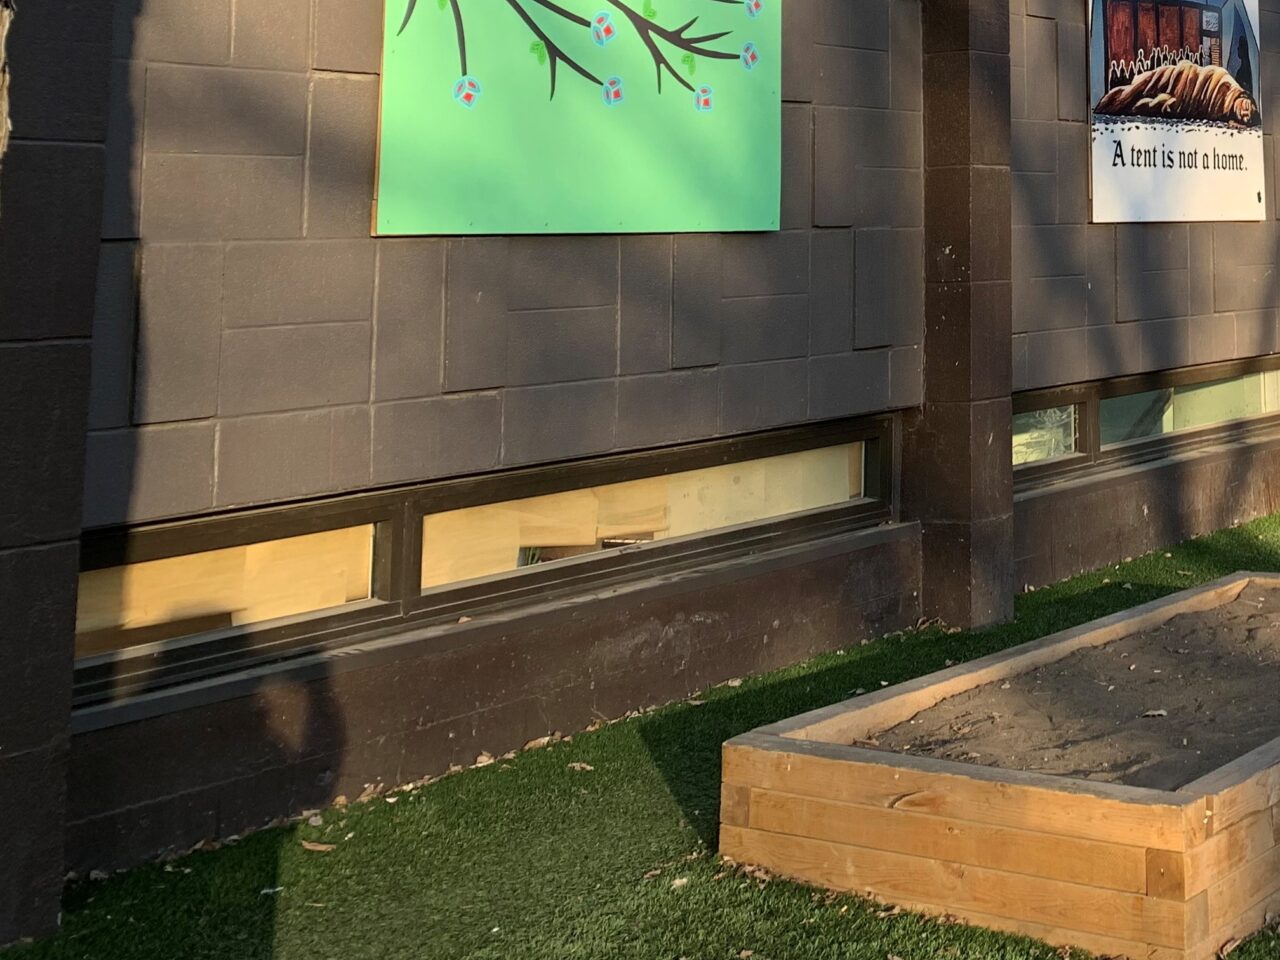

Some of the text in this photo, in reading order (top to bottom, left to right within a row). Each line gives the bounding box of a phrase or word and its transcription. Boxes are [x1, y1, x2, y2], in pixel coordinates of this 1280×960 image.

[1112, 139, 1248, 171] A tent is not a home.
